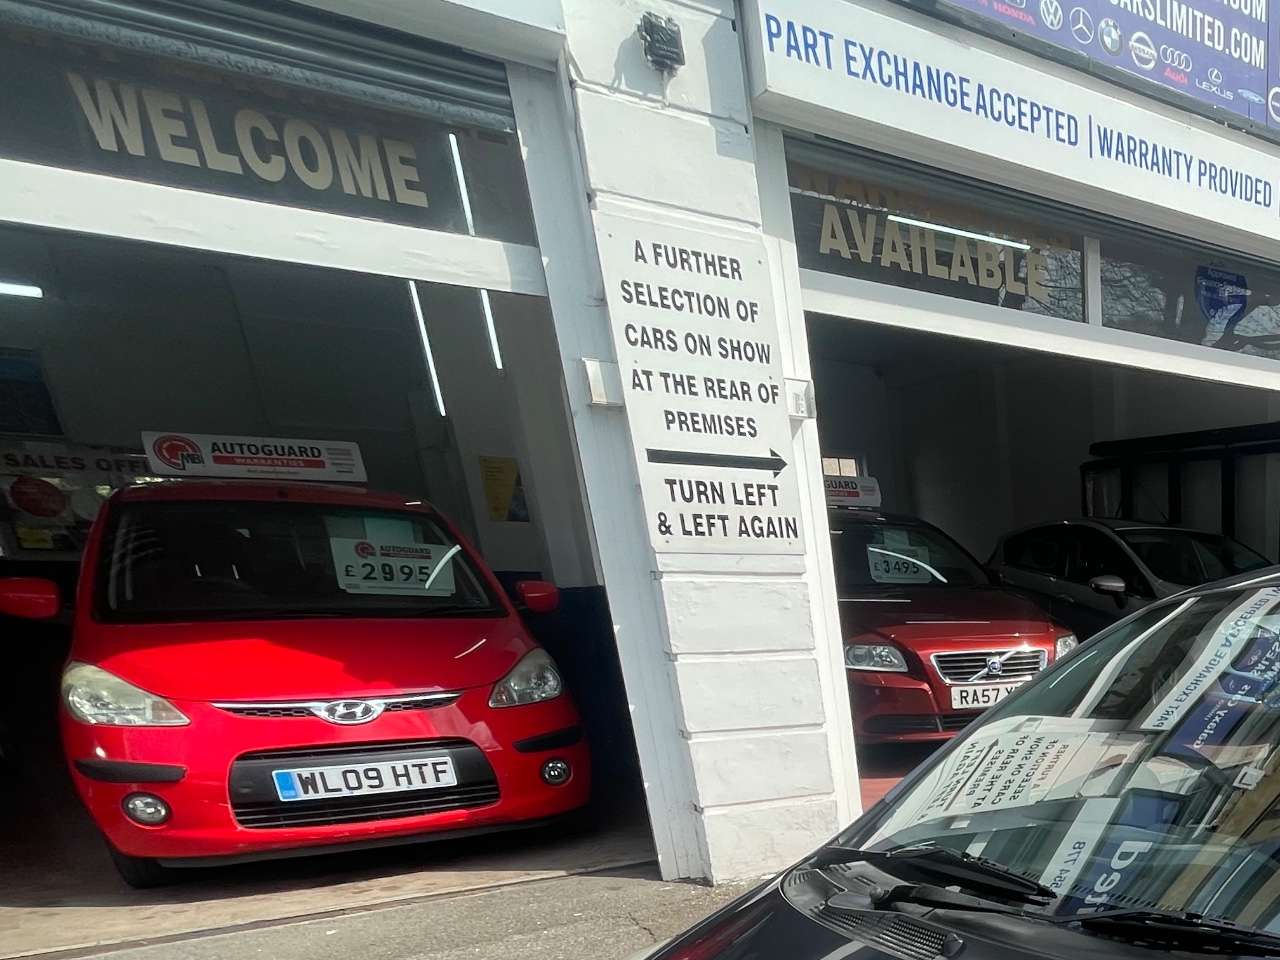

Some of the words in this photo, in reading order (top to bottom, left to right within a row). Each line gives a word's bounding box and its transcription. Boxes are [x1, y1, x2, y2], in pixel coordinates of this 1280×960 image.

[1195, 77, 1234, 101] LEXUS
[765, 13, 833, 70] PART
[844, 39, 971, 112] EXCHANGE
[975, 83, 1078, 147] ACCEPTED
[1097, 124, 1194, 183] WARRANTY
[1198, 159, 1272, 208] PROVIDED
[66, 72, 428, 208] WELCOME
[634, 239, 648, 264] A
[652, 242, 743, 281] FURTHER
[819, 203, 1050, 299] AVAILABLE
[620, 279, 730, 320] SELECTION
[736, 299, 759, 323] OF
[624, 323, 679, 353] CARS
[684, 332, 712, 357] ON
[717, 336, 771, 365] SHOW
[632, 368, 653, 392] AT
[659, 371, 699, 397] THE
[703, 376, 753, 402] REAR
[757, 382, 779, 404] OF
[663, 409, 758, 438] PREMISES
[4, 453, 87, 471] SALES
[210, 441, 322, 459] AUTOGUARD
[664, 478, 725, 504] TURN
[731, 482, 779, 507] LEFT
[824, 479, 858, 490] GUARD
[657, 512, 674, 536] &
[679, 513, 730, 537] LEFT
[738, 515, 799, 539] AGAIN
[960, 688, 999, 705] RA57
[297, 767, 384, 795] WL09
[391, 761, 448, 788] HTF
